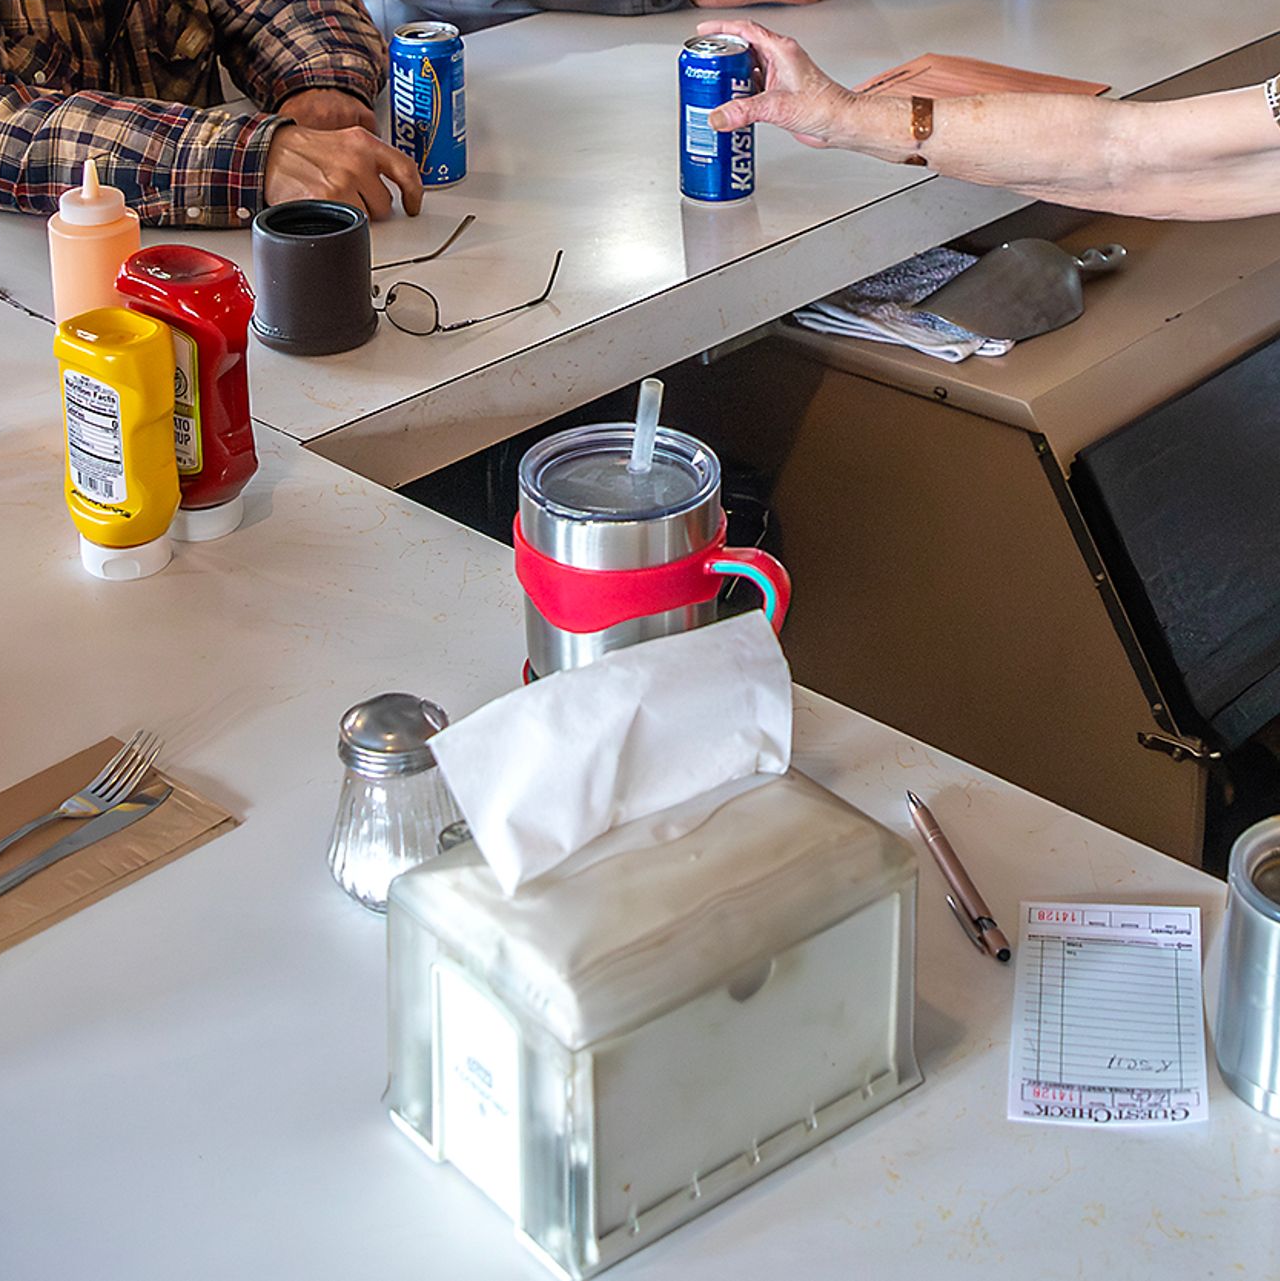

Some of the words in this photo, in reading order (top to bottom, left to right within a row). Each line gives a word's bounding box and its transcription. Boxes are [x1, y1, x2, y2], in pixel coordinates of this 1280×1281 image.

[393, 61, 416, 159] EYSTONE
[415, 72, 432, 119] LIGHT
[730, 78, 753, 191] KEYSE
[111, 420, 119, 431] 0
[1037, 911, 1077, 924] 14128
